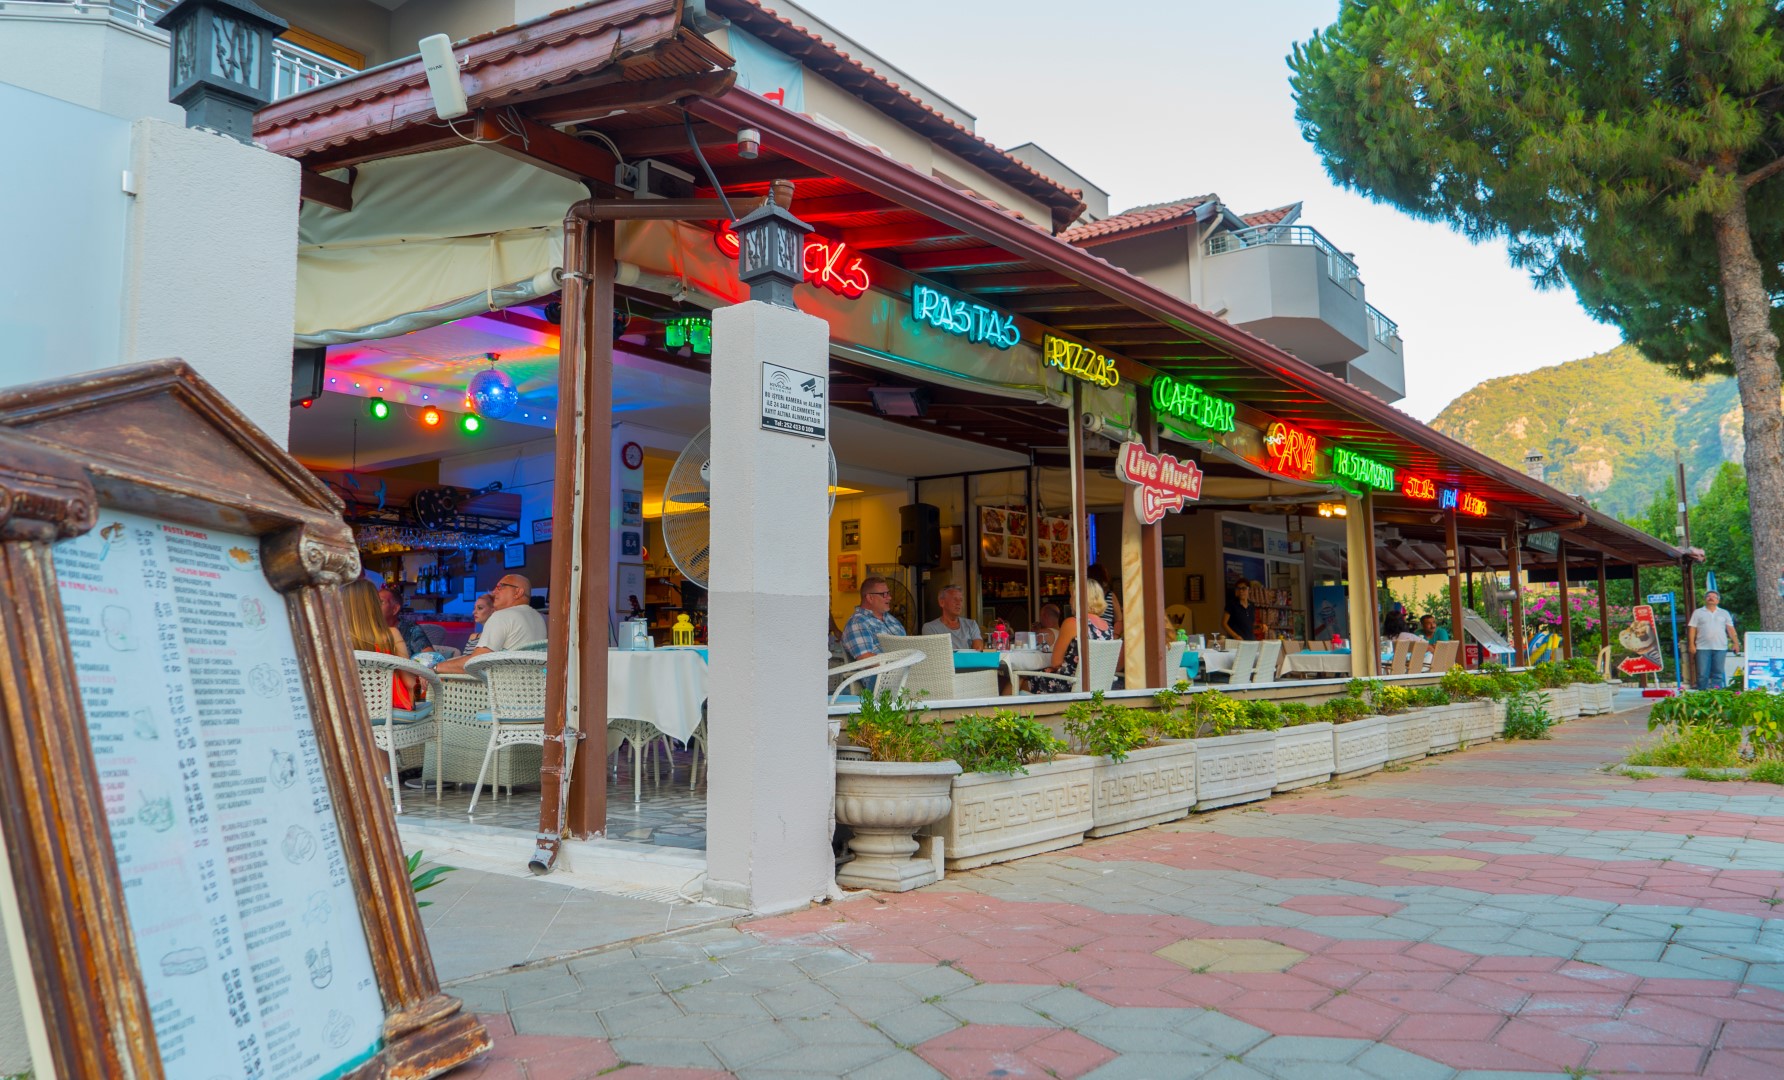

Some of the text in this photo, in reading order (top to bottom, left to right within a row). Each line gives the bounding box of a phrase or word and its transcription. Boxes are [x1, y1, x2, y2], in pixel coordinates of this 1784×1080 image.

[1046, 336, 1120, 387] PIZZAS
[786, 396, 802, 405] KAMERA
[1156, 376, 1237, 432] CAFE BAR
[1128, 450, 1199, 492] Live Music
[1336, 447, 1395, 491] RESTAURANT
